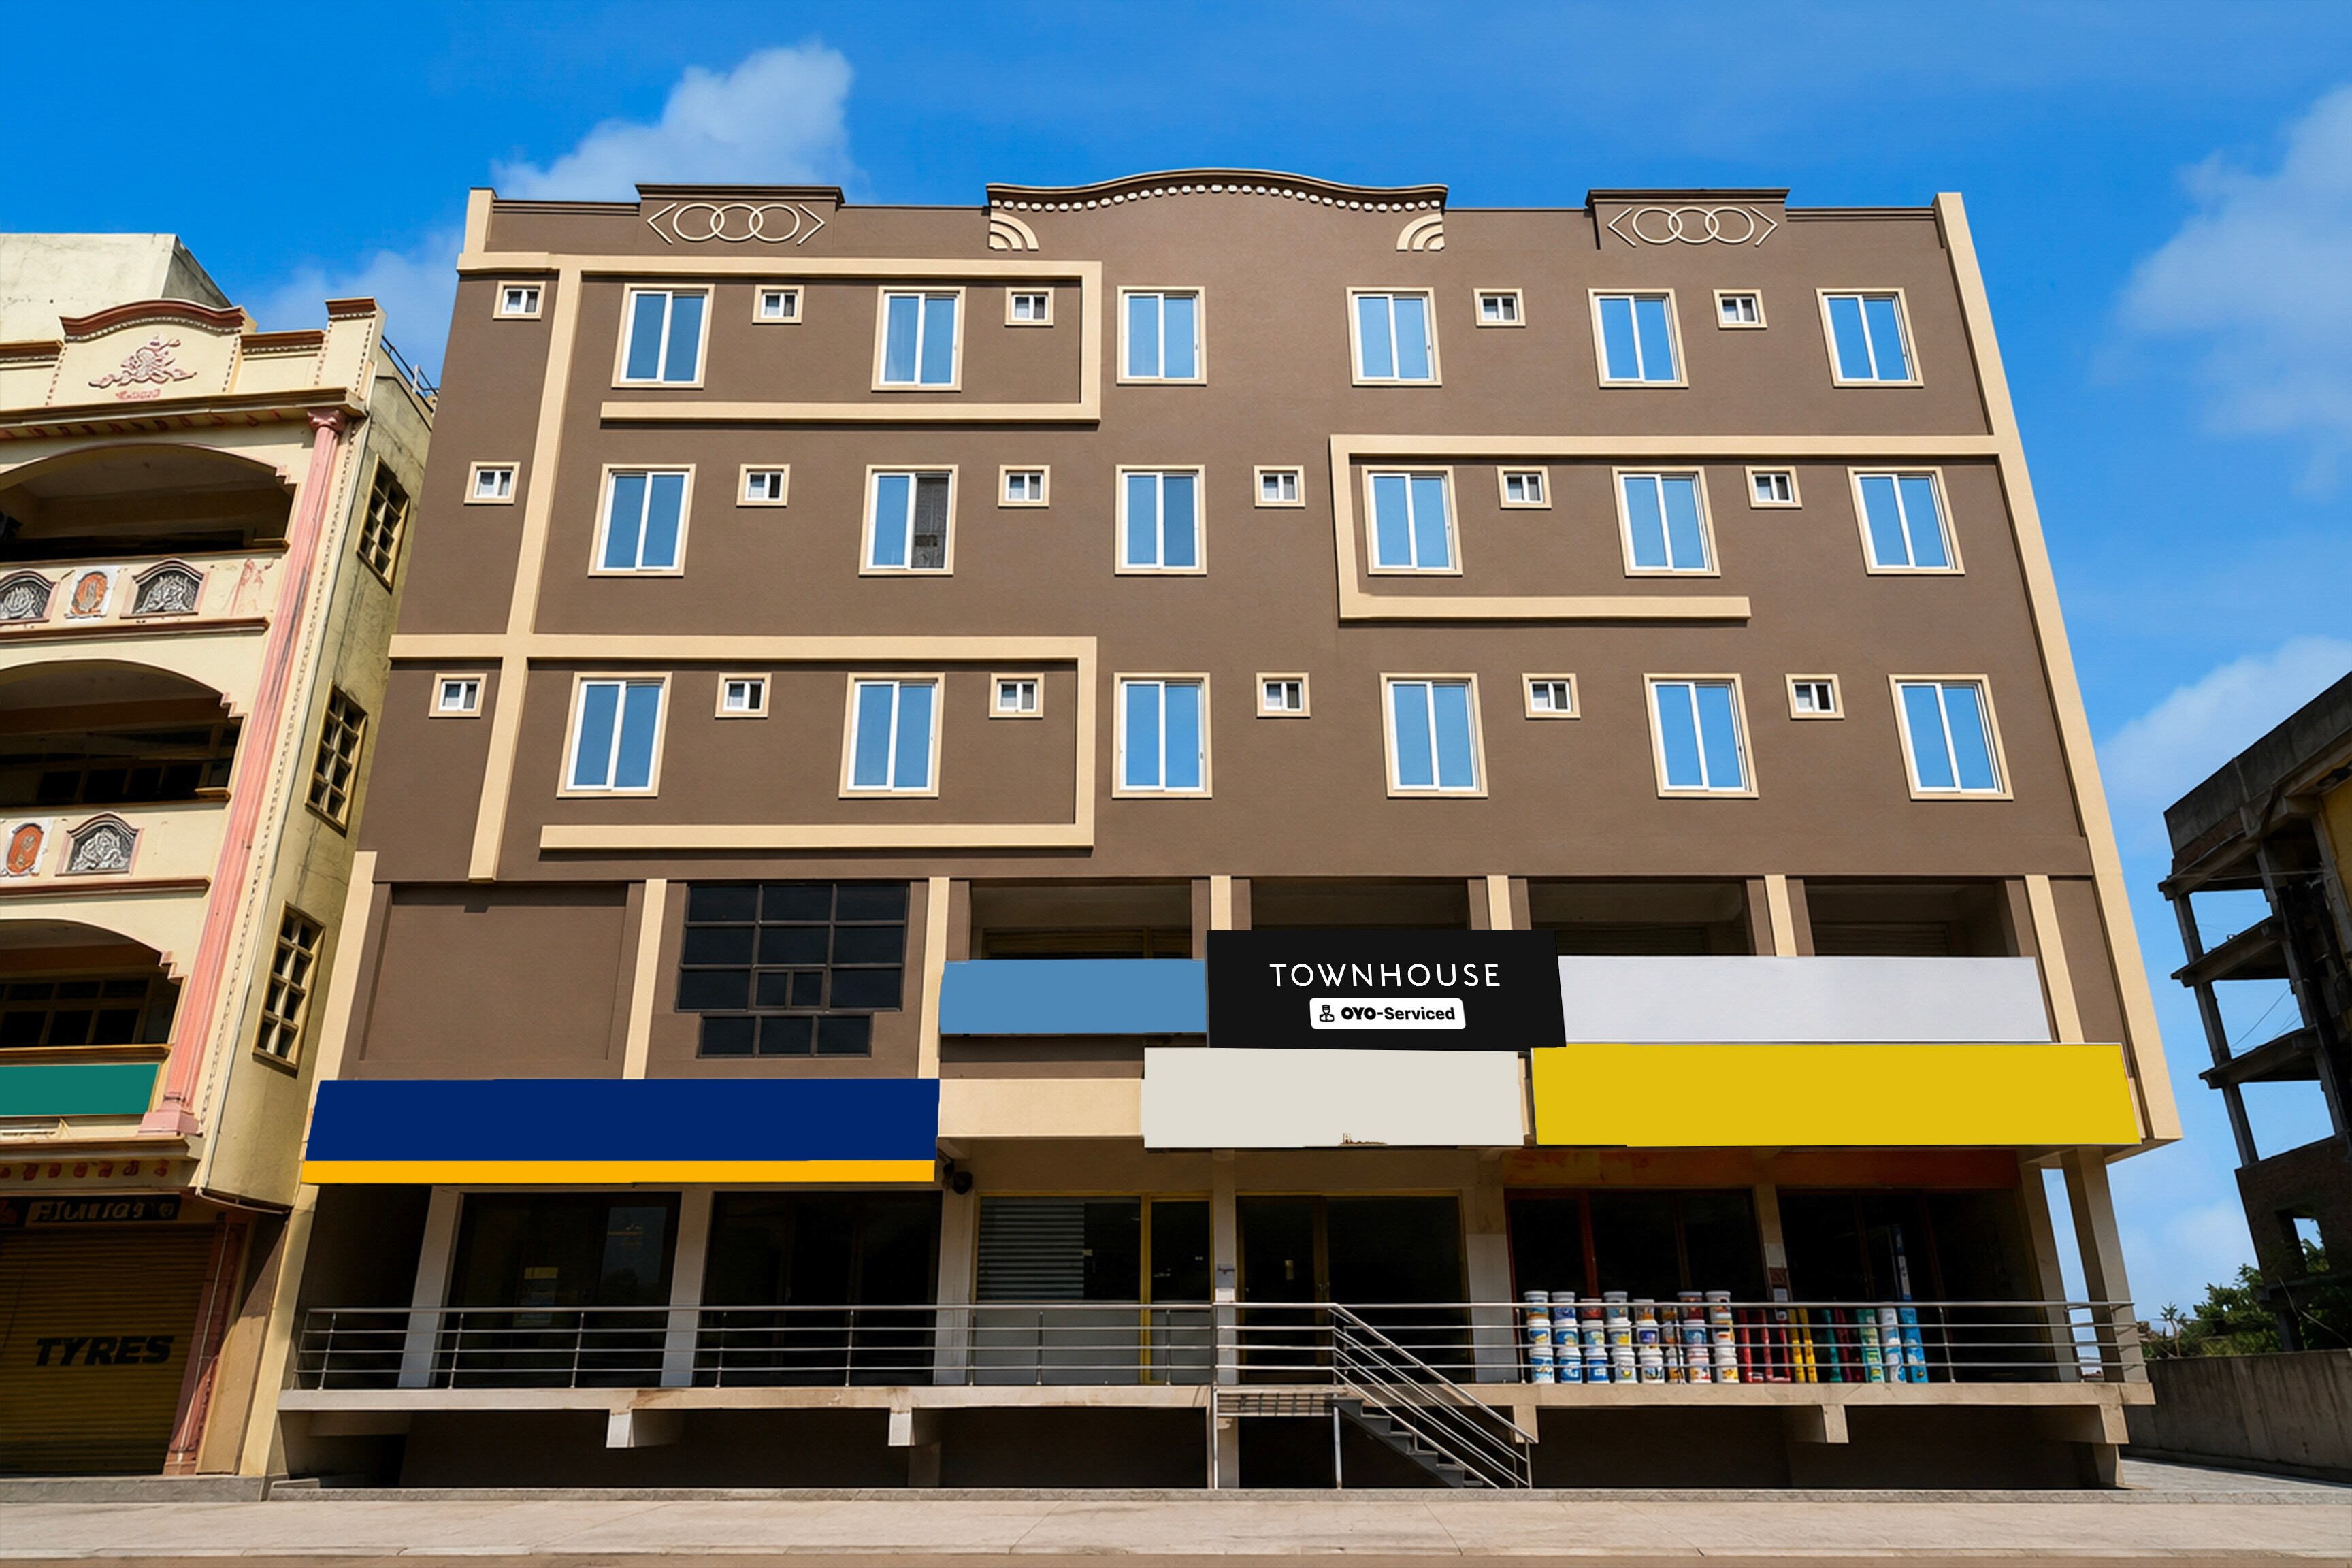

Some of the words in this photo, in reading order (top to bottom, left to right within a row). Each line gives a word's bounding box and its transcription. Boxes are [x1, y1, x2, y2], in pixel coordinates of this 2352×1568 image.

[1269, 963, 1501, 987] TOWNHOUSE
[1341, 1006, 1456, 1021] OYO-Serviced
[35, 1335, 174, 1366] TYRES
